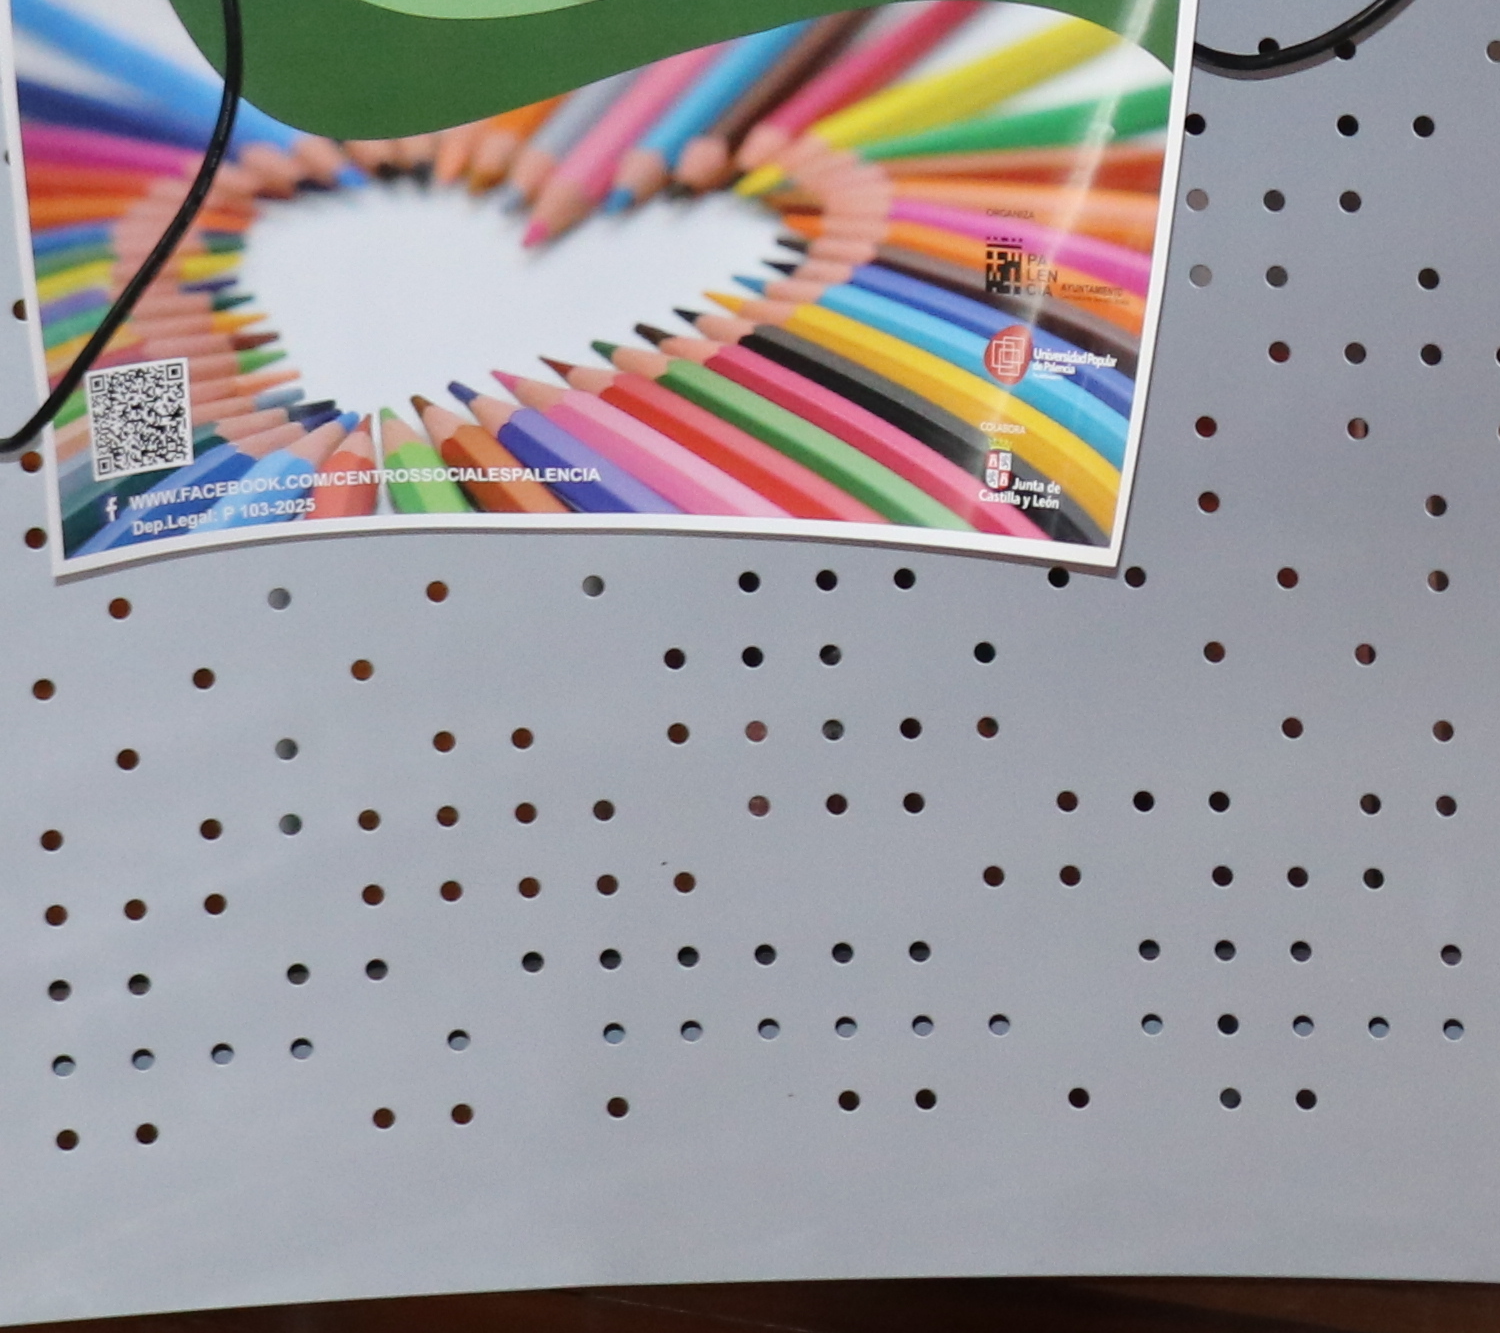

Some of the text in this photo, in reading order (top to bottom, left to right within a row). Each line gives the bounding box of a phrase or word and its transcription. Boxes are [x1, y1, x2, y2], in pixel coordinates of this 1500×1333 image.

[1027, 269, 1058, 283] LEN
[1033, 347, 1118, 369] Universidad Popular
[129, 467, 602, 511] WWW.FACEBOOK.COM/CENTROSSOCIALESPALENCIA
[1012, 478, 1061, 494] Junta de
[224, 507, 235, 521] P
[241, 497, 316, 519] 103-2025
[979, 489, 1060, 509] Castilla y León
